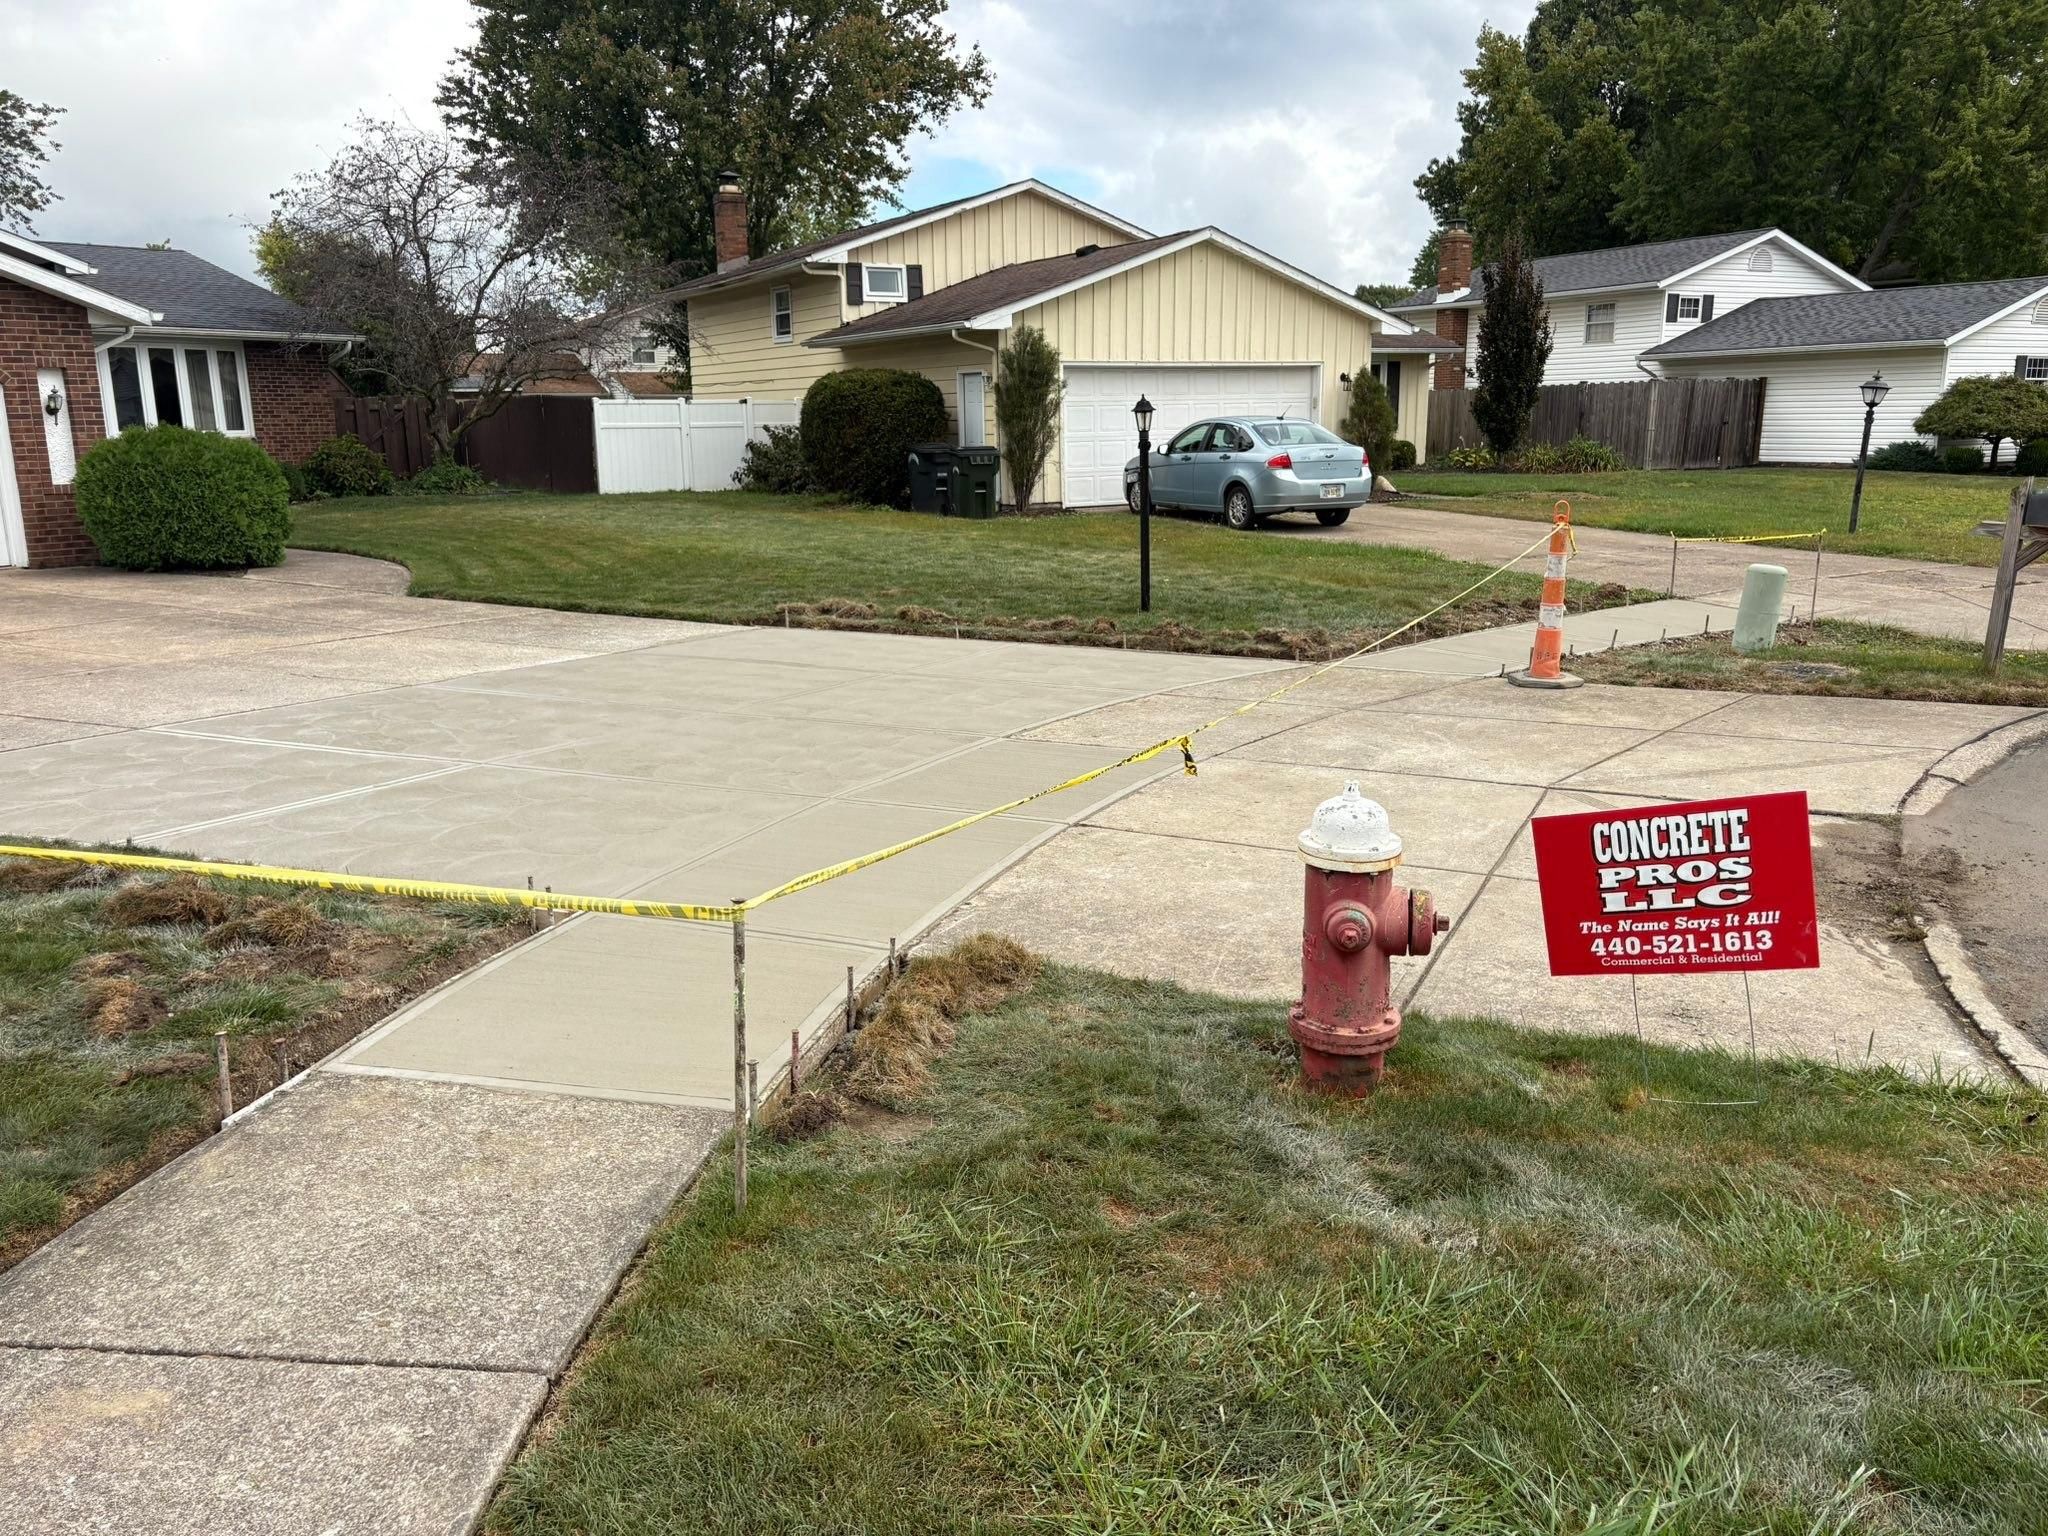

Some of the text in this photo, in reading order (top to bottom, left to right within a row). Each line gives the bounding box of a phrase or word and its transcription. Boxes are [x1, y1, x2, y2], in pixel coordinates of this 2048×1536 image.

[1593, 809, 1750, 864] CONCRETE
[1598, 857, 1753, 888] PROS
[1601, 883, 1752, 912] LLC
[1579, 911, 1780, 934] The Name Says It All!
[1590, 930, 1773, 956] 440-521-1613
[1601, 952, 1763, 966] Commercial & Residential
